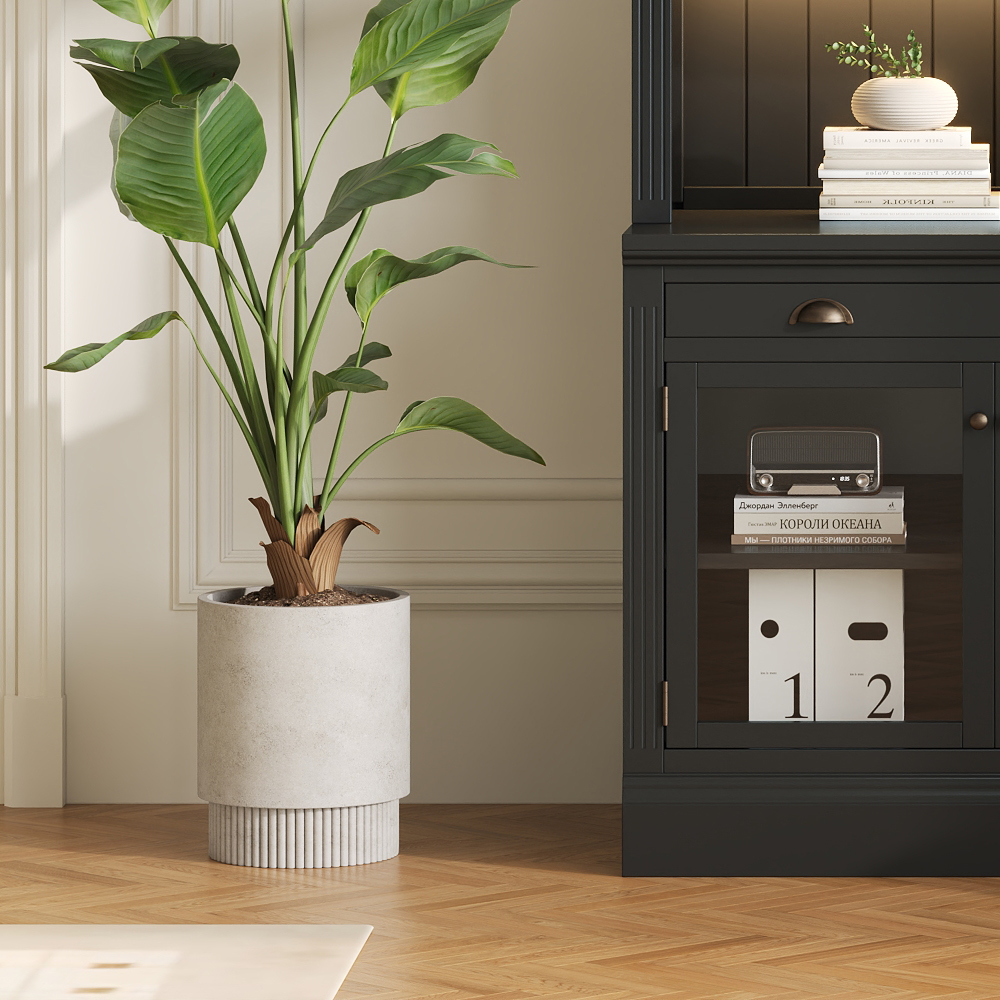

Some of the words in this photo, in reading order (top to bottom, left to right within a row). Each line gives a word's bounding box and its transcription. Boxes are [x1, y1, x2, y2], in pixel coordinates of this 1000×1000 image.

[738, 501, 775, 510] Джордан
[777, 502, 819, 510] Элленберг
[780, 519, 829, 529] КОРОЛИ
[832, 519, 882, 529] ОКЕАНА
[784, 672, 809, 718] 1
[867, 673, 895, 718] 2
